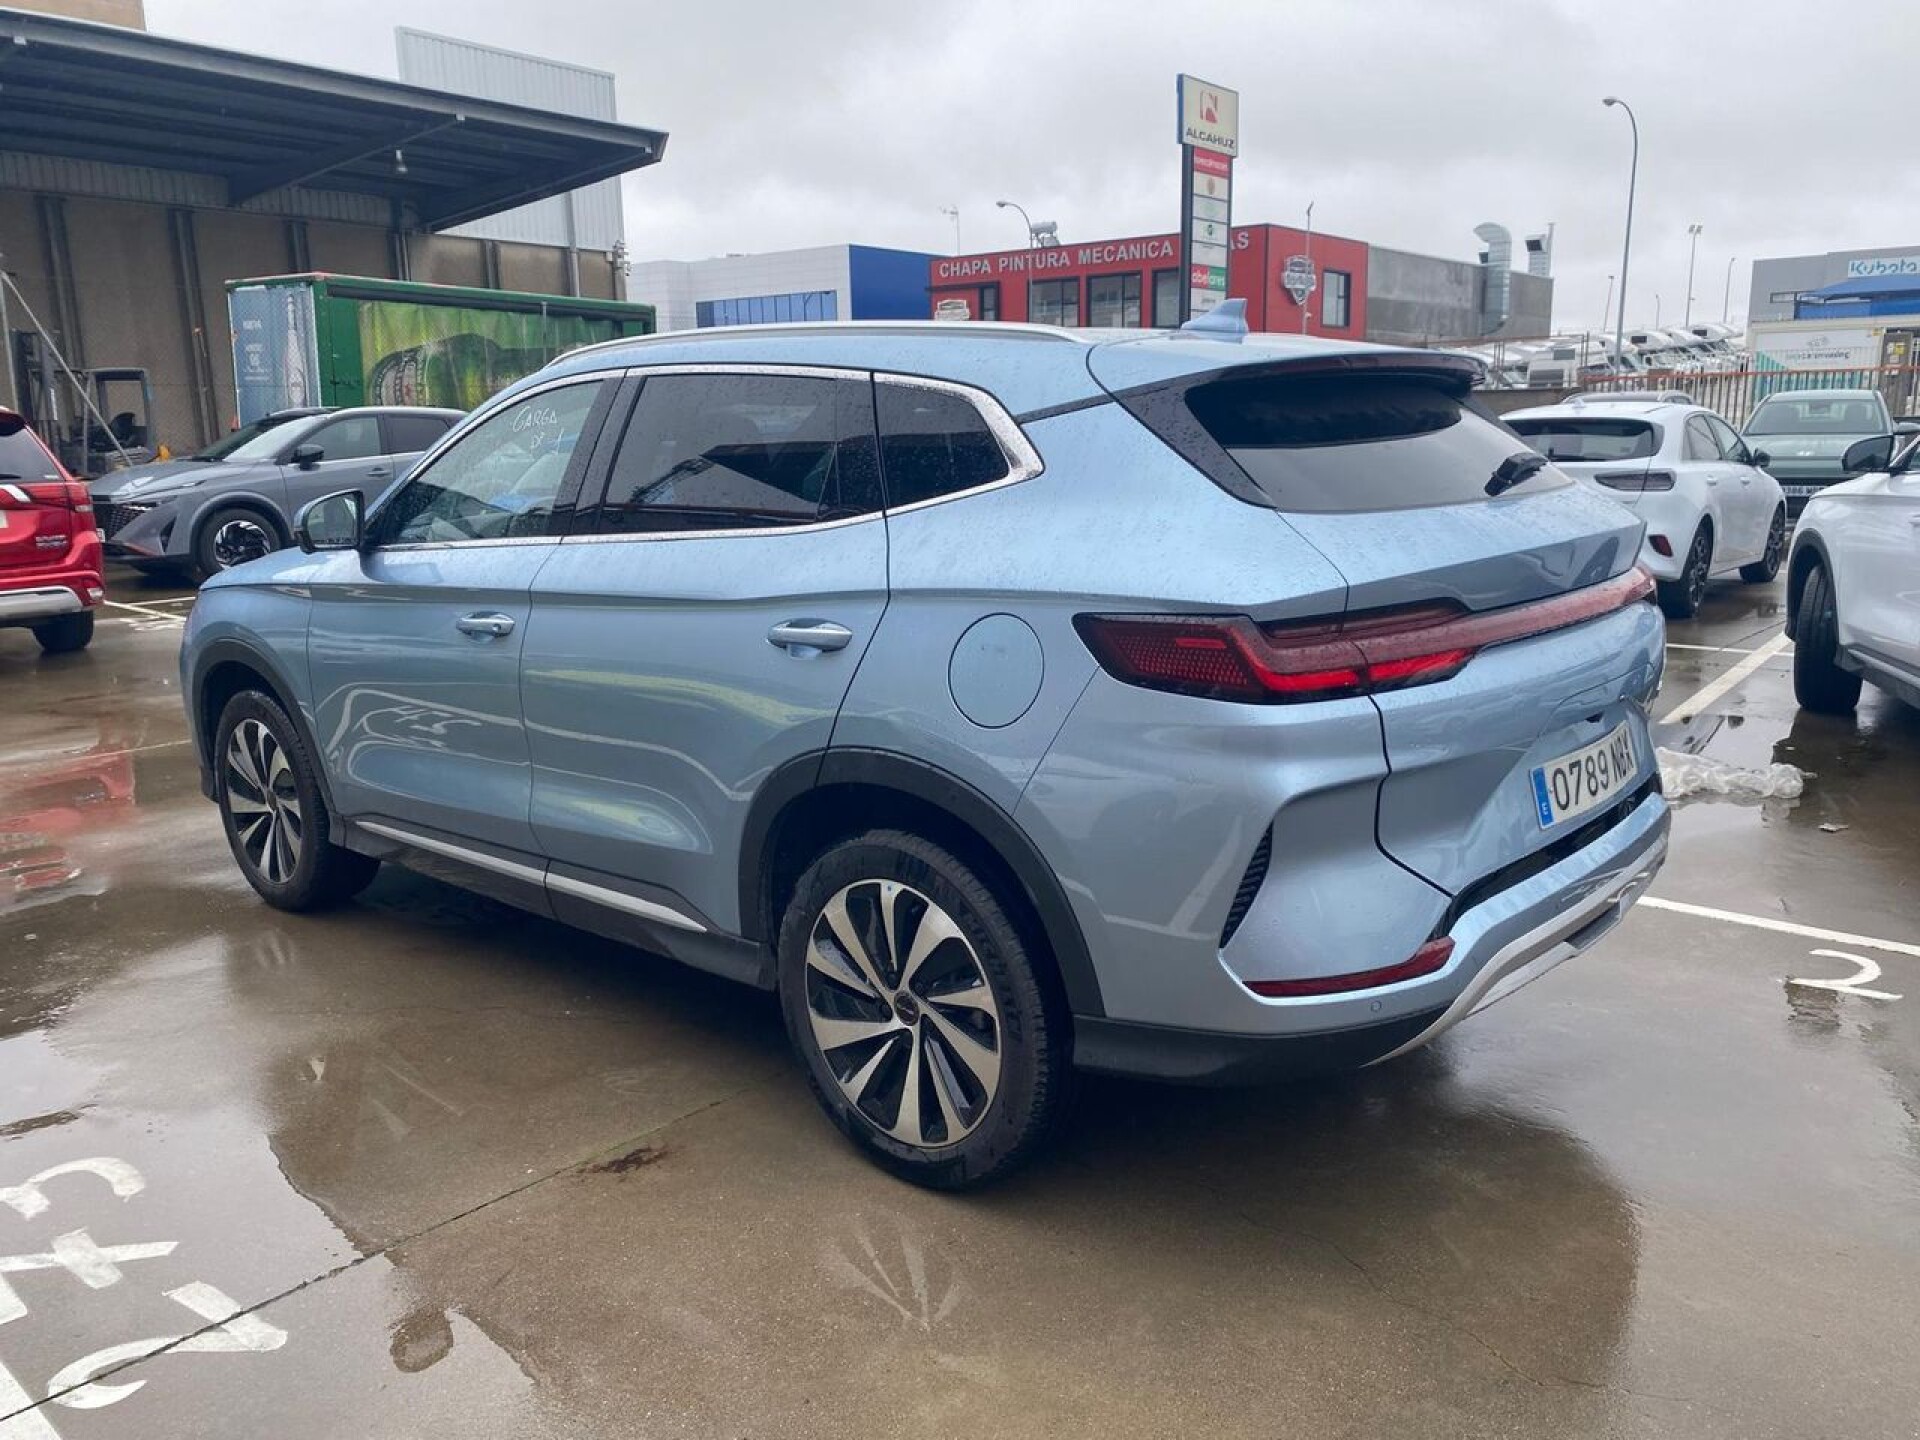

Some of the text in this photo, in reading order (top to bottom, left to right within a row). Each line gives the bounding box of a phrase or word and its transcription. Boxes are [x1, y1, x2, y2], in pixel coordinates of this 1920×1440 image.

[939, 258, 992, 278] CHAPA
[998, 251, 1071, 273] PINTURA
[1078, 239, 1174, 265] MECANICA
[1850, 257, 1918, 276] Kubota
[1553, 750, 1609, 810] 0789
